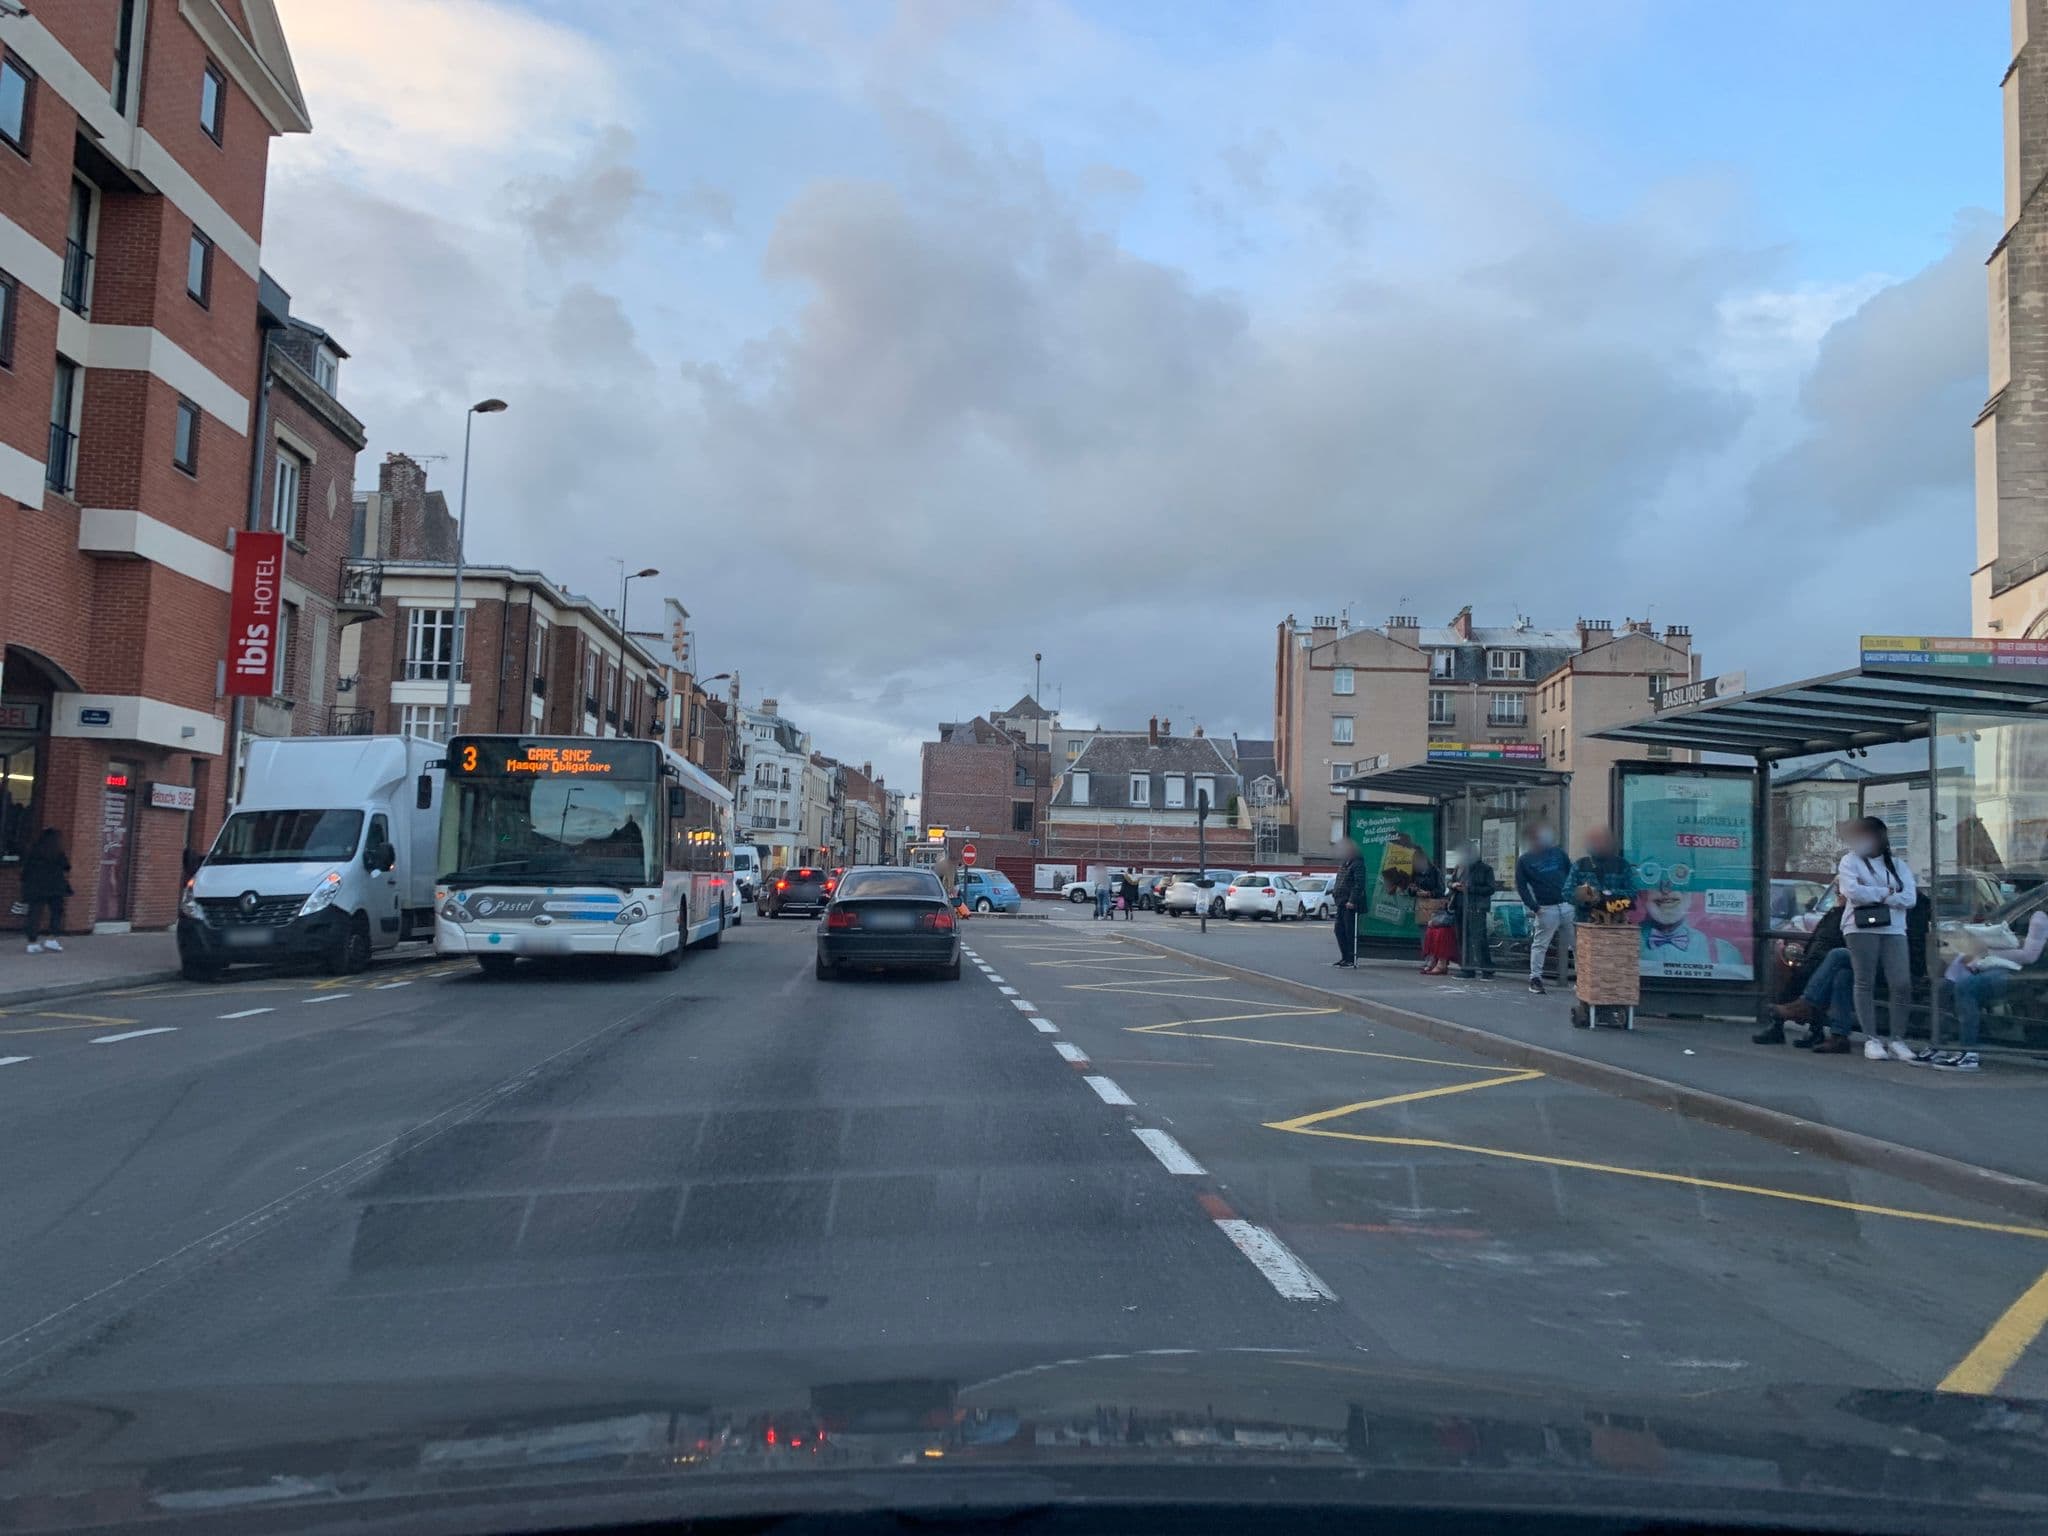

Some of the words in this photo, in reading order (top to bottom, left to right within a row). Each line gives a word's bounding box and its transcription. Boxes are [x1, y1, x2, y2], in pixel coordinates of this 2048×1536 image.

[236, 624, 270, 675] ibis
[253, 555, 275, 615] HOTEL
[1662, 682, 1706, 709] BASILIQUE
[462, 745, 477, 772] 3
[528, 748, 558, 761] GARE
[562, 749, 593, 761] SNCF
[506, 759, 549, 773] Masque
[552, 760, 611, 773] Obligatoire
[1677, 815, 1691, 825] LA
[1677, 835, 1690, 846] LE
[1694, 836, 1739, 849] SOURIRE
[495, 899, 535, 913] Pastel
[1707, 892, 1715, 908] 1
